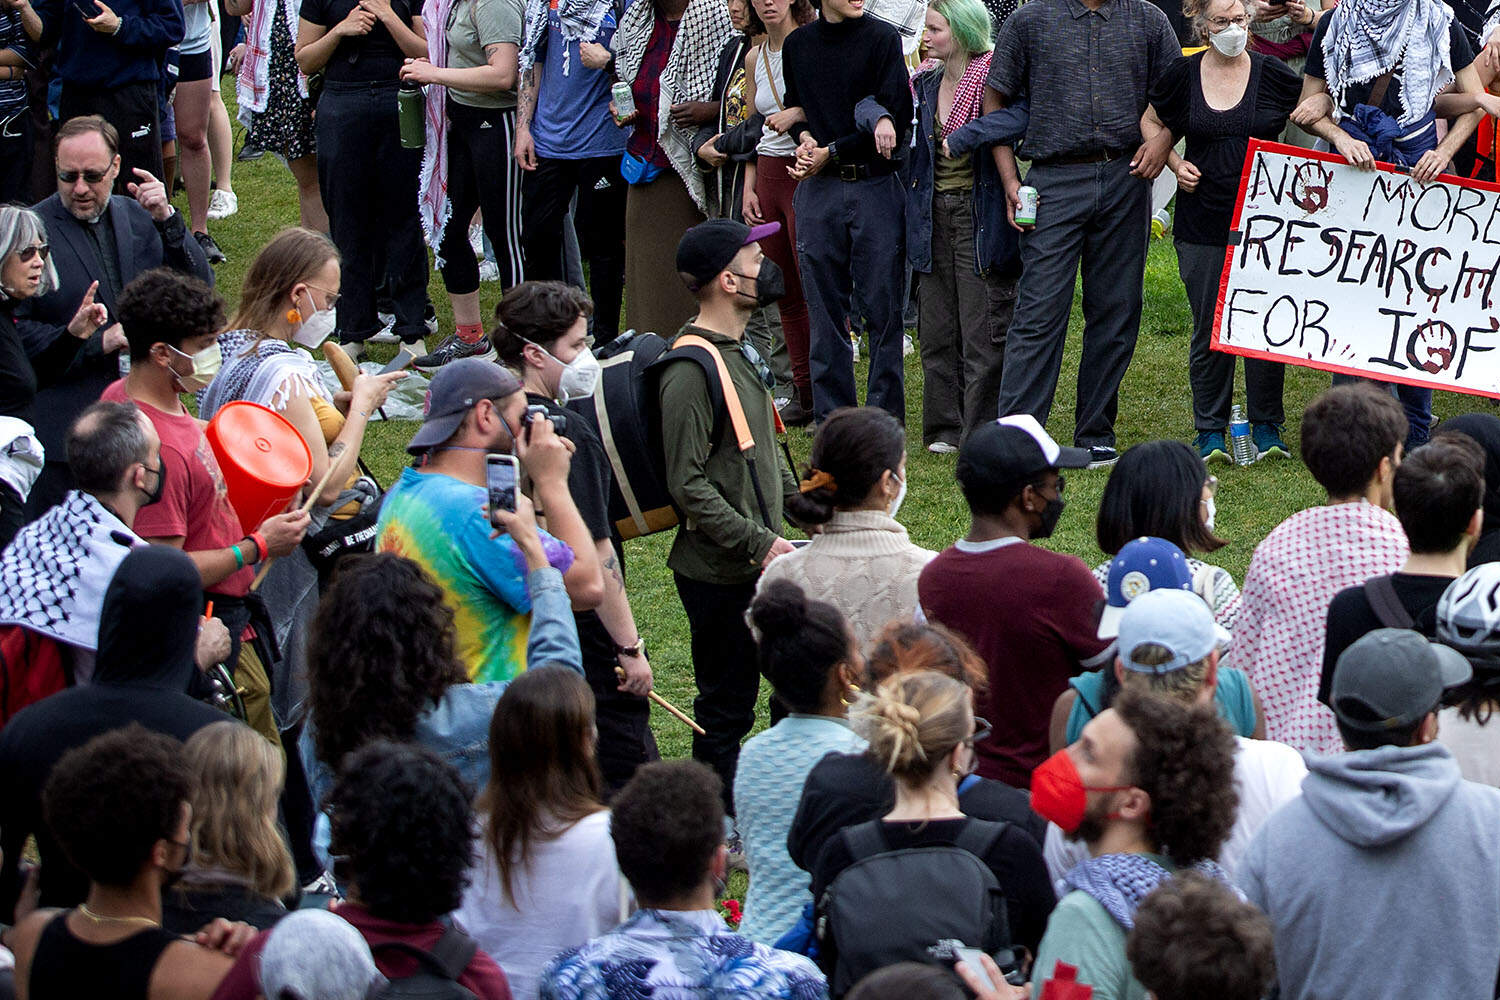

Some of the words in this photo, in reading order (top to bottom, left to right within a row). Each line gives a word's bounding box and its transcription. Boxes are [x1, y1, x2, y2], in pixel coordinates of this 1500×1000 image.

[1250, 152, 1331, 213] NO
[1227, 288, 1330, 357] FOR
[1368, 307, 1500, 380] IOF
